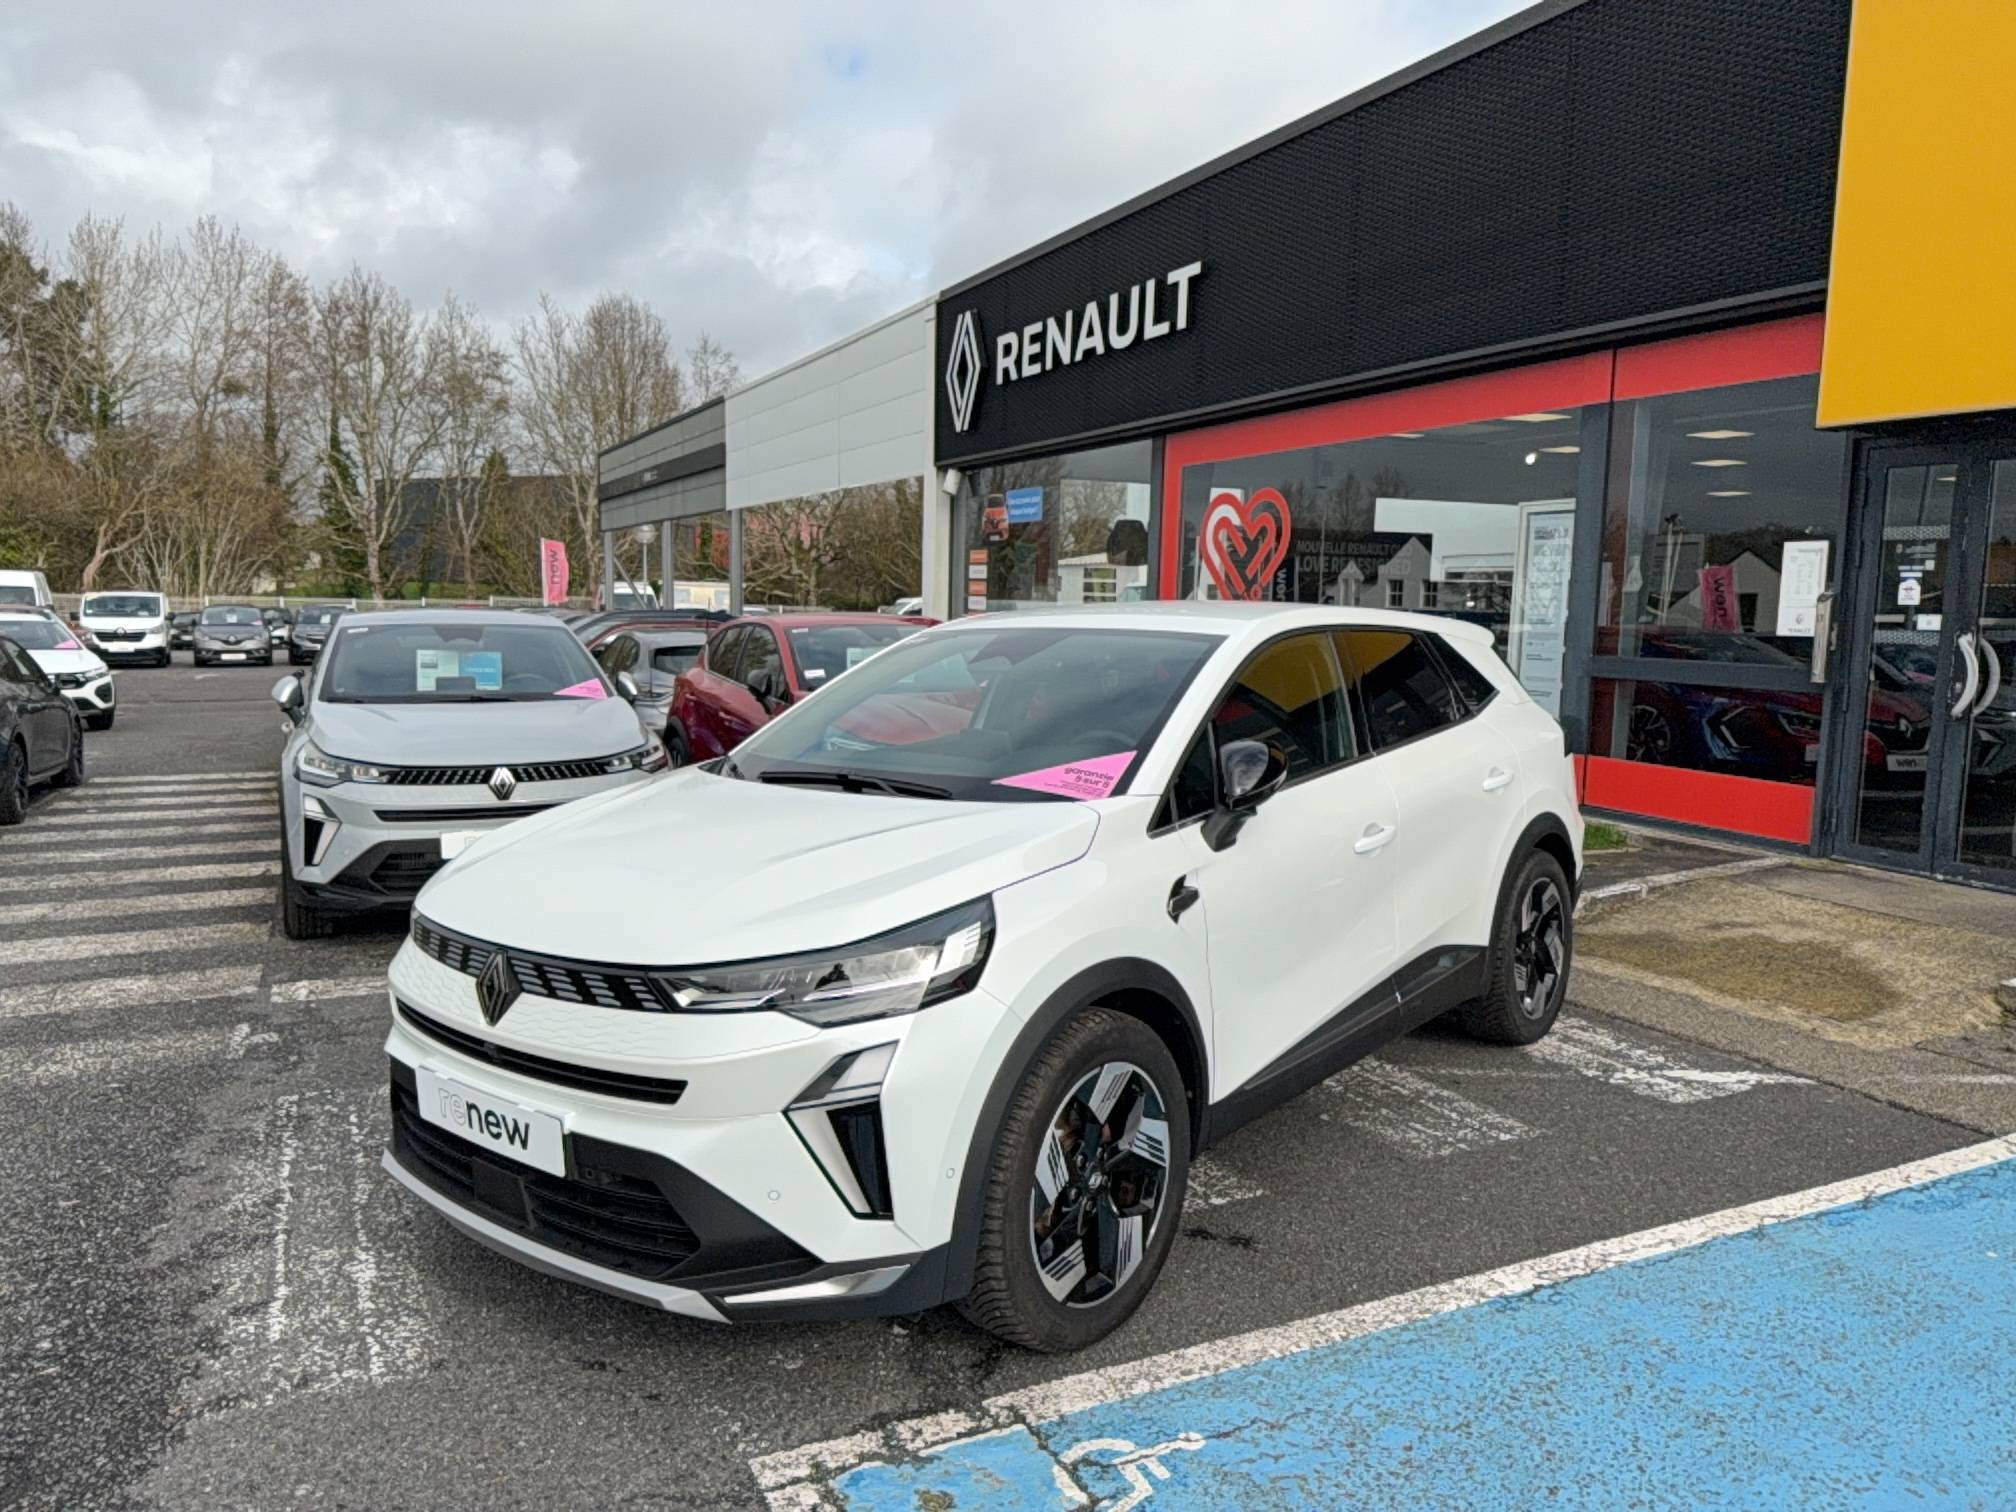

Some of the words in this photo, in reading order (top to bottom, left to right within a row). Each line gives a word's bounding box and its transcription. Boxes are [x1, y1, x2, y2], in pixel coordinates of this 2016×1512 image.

[997, 261, 1202, 385] RENAULT
[1064, 767, 1114, 781] garantie
[1083, 777, 1102, 786] sur
[438, 1087, 530, 1150] renew
